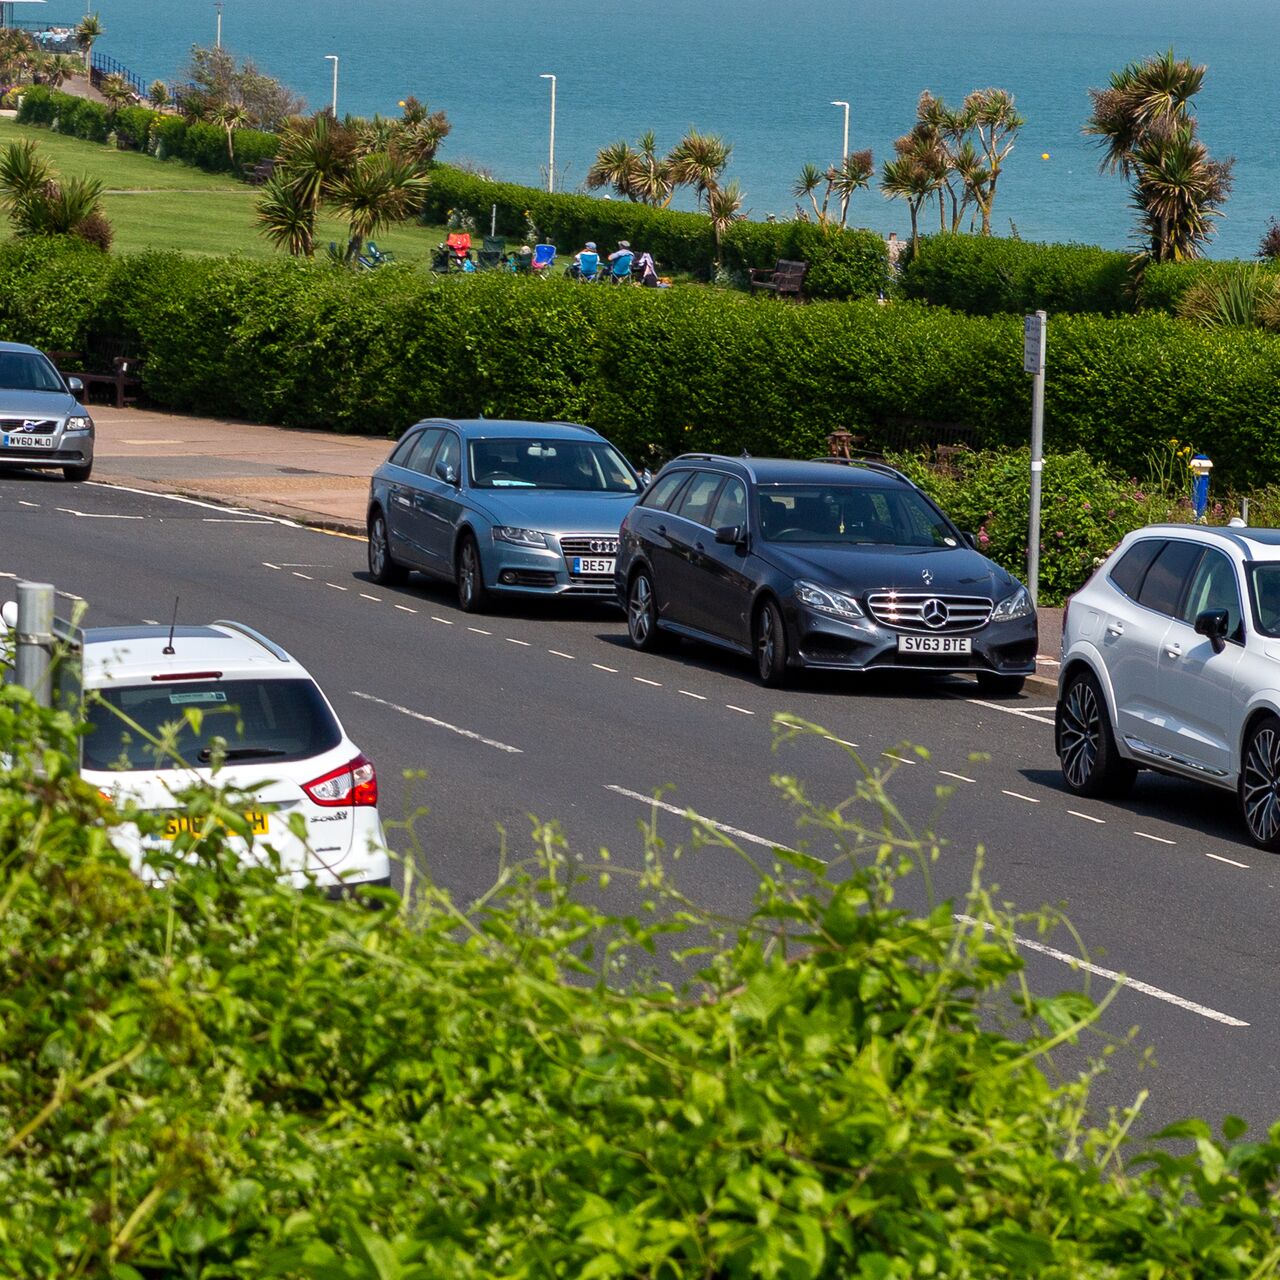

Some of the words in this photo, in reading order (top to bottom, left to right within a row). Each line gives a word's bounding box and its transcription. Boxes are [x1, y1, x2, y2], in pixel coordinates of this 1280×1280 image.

[582, 560, 613, 571] BE57
[905, 637, 940, 651] SV63
[943, 638, 967, 651] BTE
